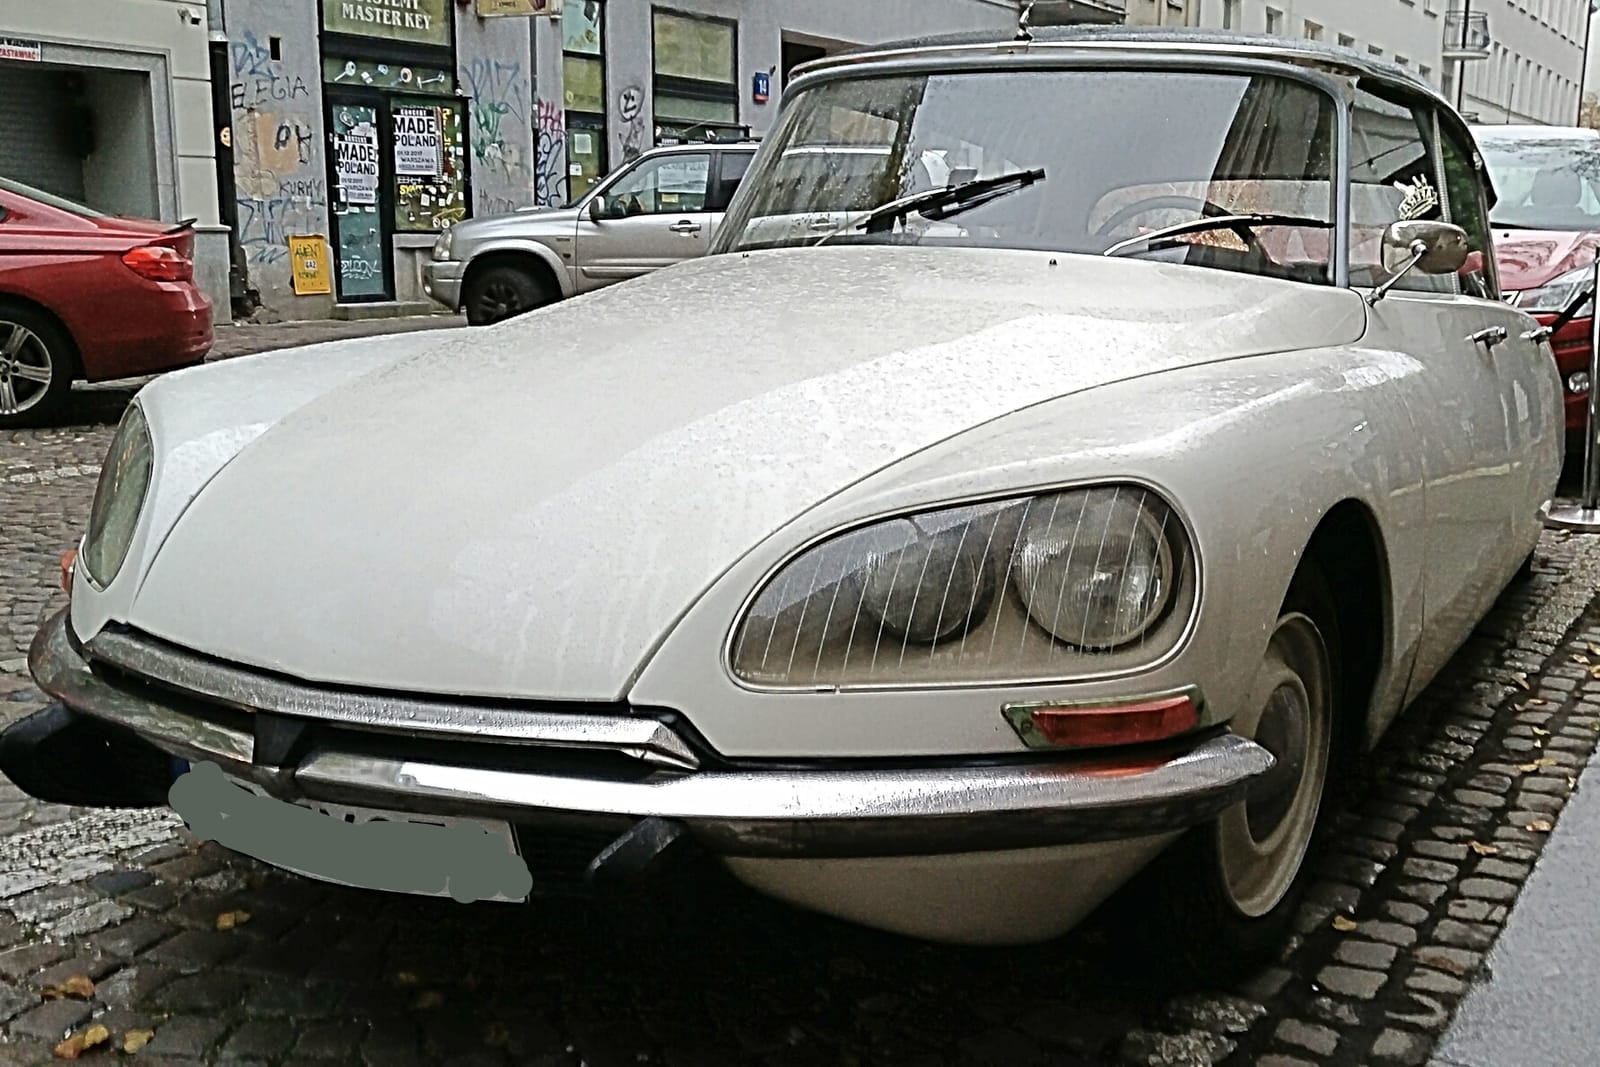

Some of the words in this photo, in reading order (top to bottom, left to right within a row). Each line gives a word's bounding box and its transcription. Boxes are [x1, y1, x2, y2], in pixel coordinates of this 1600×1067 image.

[342, 3, 402, 26] MASTER
[404, 12, 432, 30] KEY
[759, 79, 767, 95] 14
[393, 117, 436, 134] MADE
[394, 134, 436, 147] POLAND
[338, 143, 376, 163] MADE
[338, 161, 376, 175] POLAND
